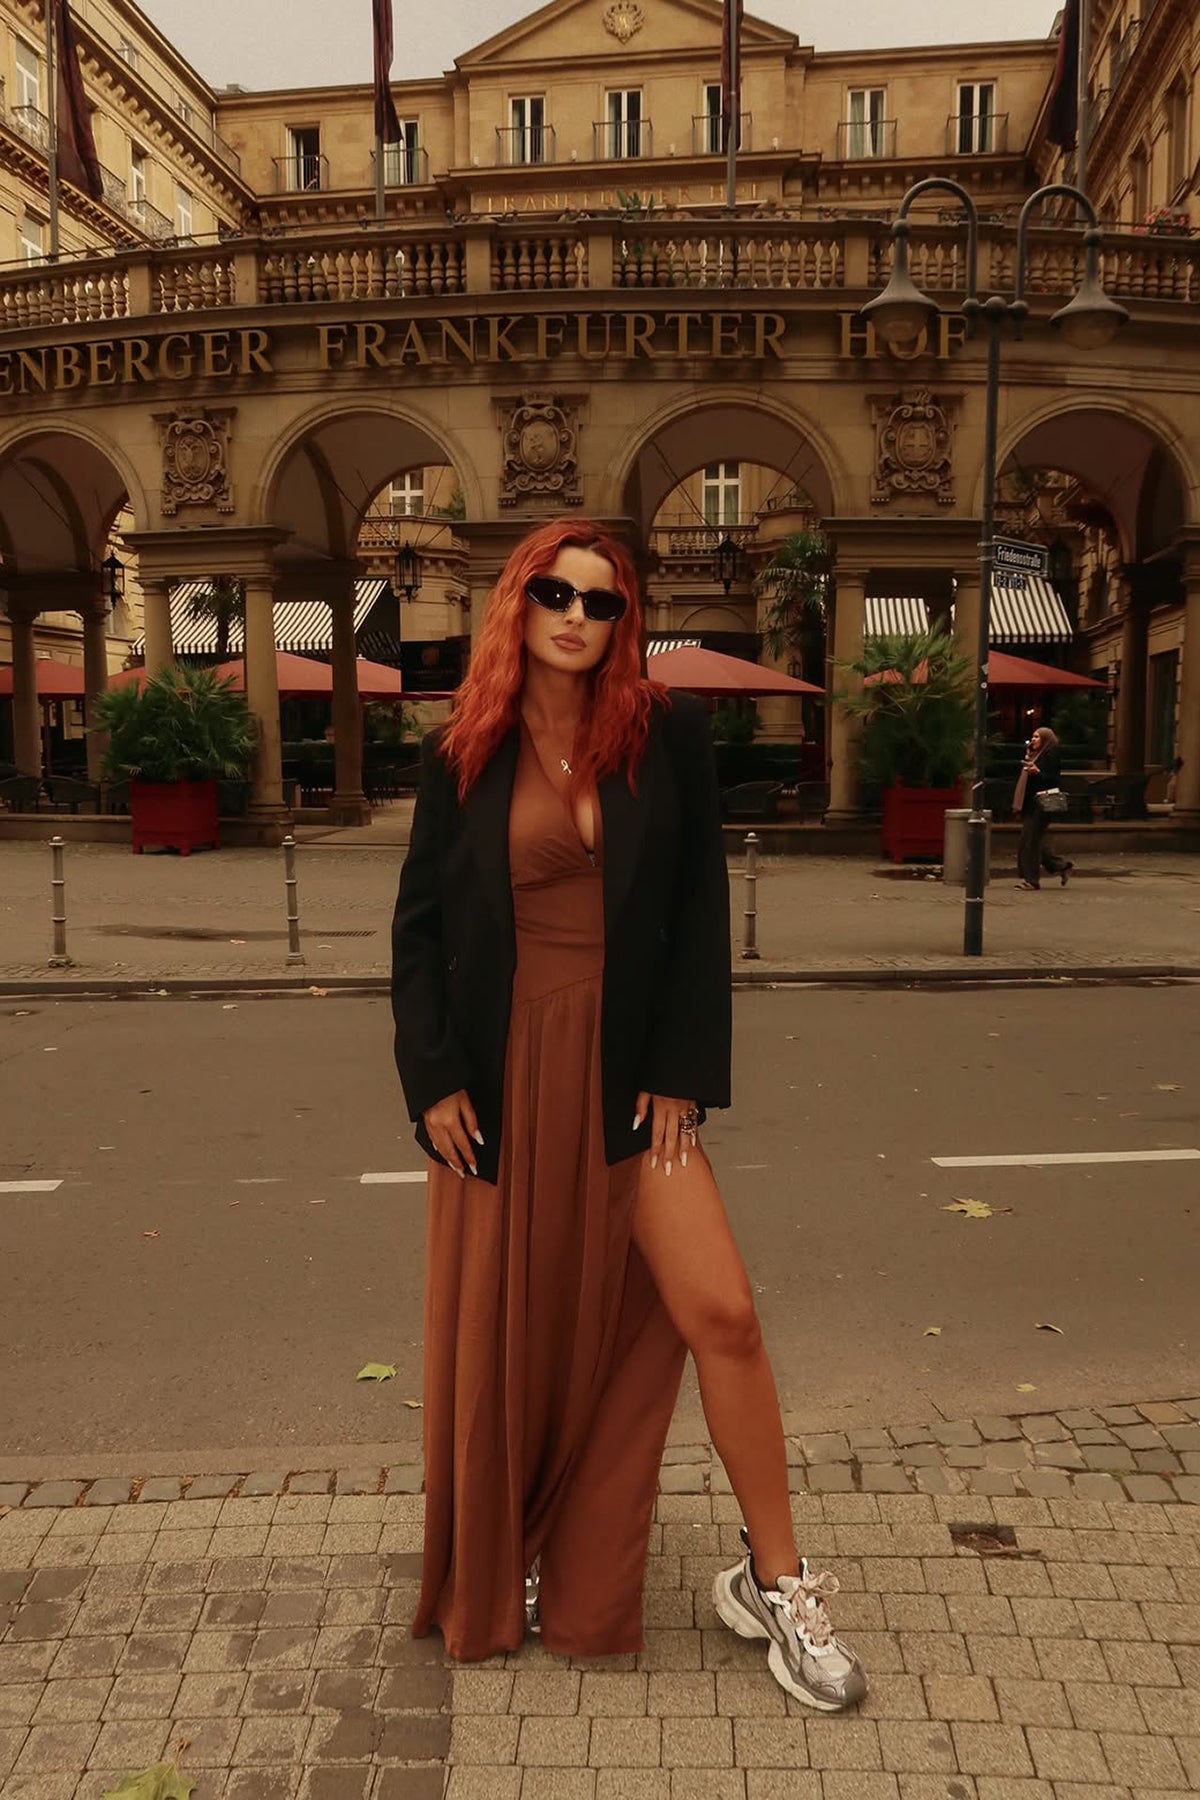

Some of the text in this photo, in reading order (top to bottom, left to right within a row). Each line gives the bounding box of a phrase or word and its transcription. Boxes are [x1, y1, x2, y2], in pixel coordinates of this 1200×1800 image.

[488, 184, 692, 213] FRANKFUTER
[316, 312, 788, 370] FRANKFURTER
[997, 546, 1041, 569] Friedensstraße
